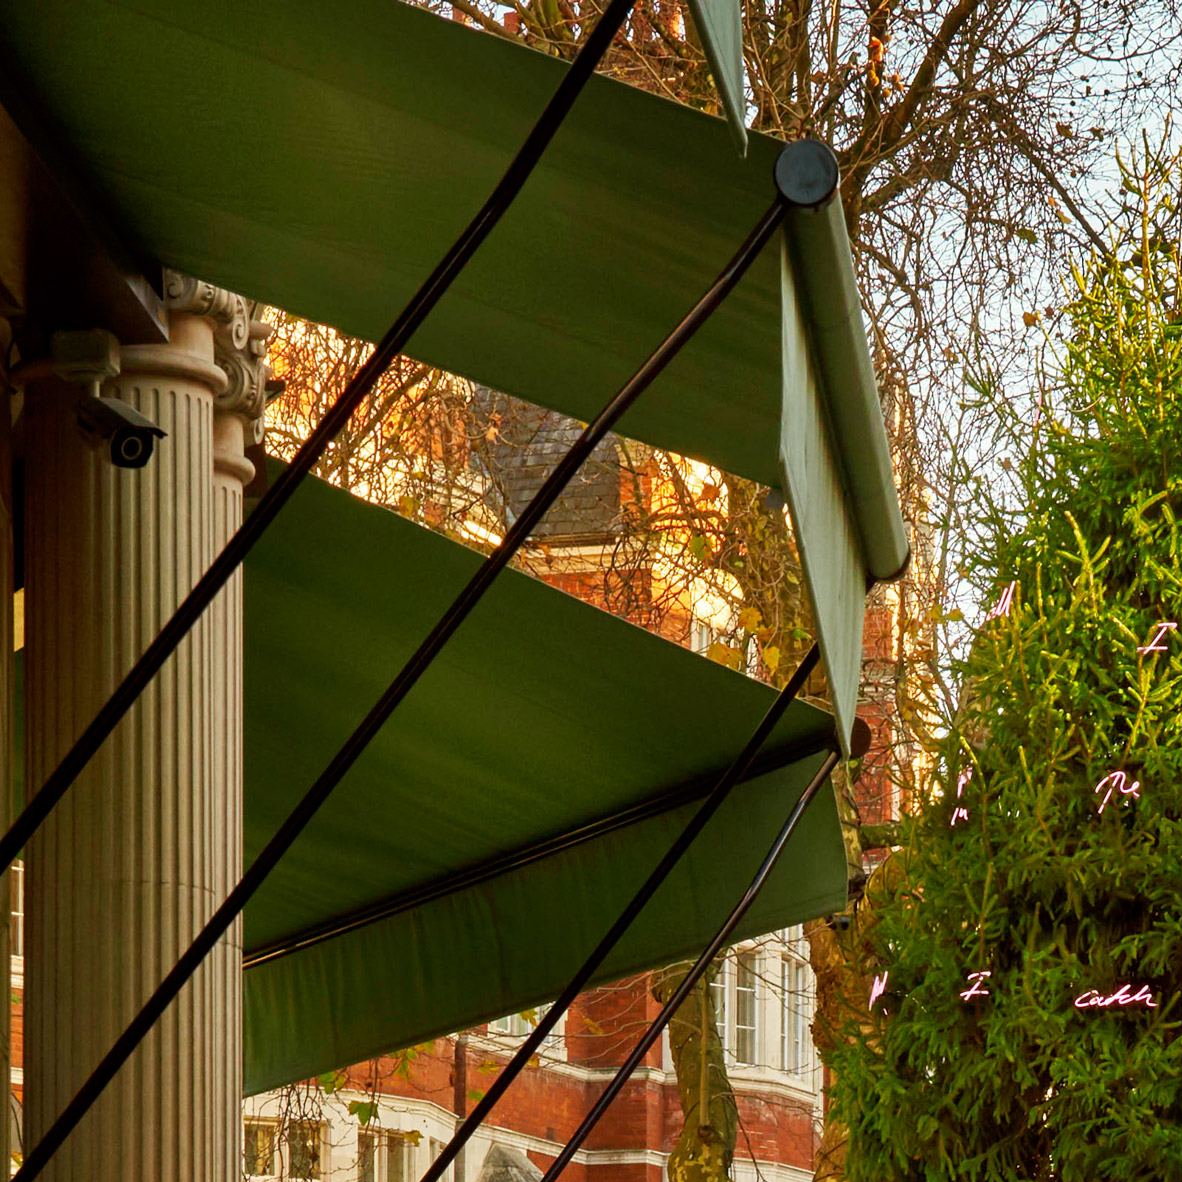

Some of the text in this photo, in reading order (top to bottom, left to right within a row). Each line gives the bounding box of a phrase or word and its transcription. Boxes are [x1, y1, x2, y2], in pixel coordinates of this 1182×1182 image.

[1137, 622, 1177, 652] I
[1094, 770, 1140, 814] The
[959, 970, 992, 1001] I
[1074, 983, 1158, 1008] catch
